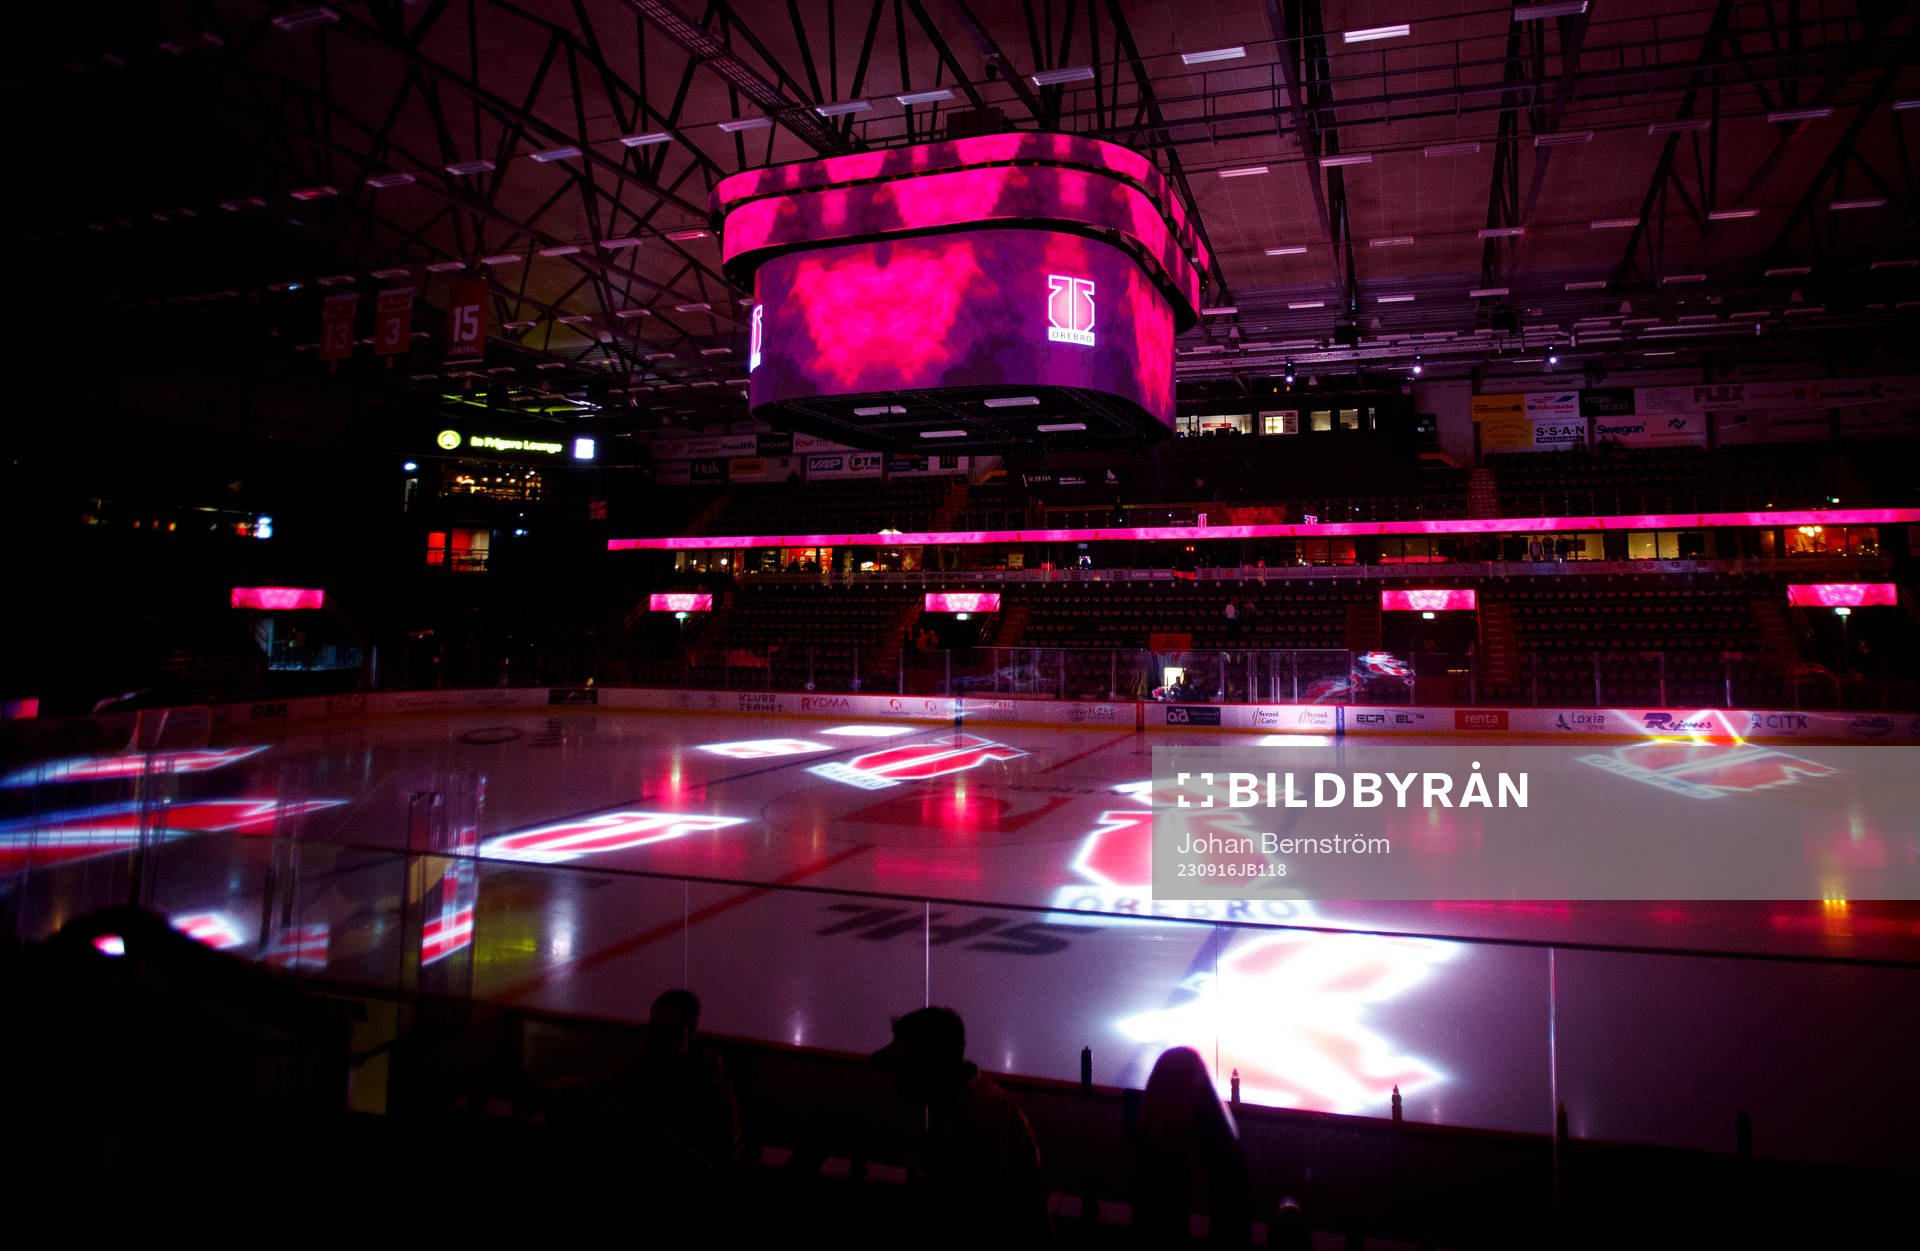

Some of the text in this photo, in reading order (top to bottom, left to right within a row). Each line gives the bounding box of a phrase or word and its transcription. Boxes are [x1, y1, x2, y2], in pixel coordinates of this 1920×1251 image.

[453, 304, 480, 343] 15
[384, 317, 401, 345] 3
[1596, 420, 1645, 436] Swegon
[1259, 710, 1280, 718] Svensk
[1307, 711, 1328, 719] Svensk
[1464, 713, 1499, 725] renta
[1571, 713, 1605, 725] Loxia
[1261, 717, 1279, 725] Cater
[1766, 715, 1808, 729] CITK
